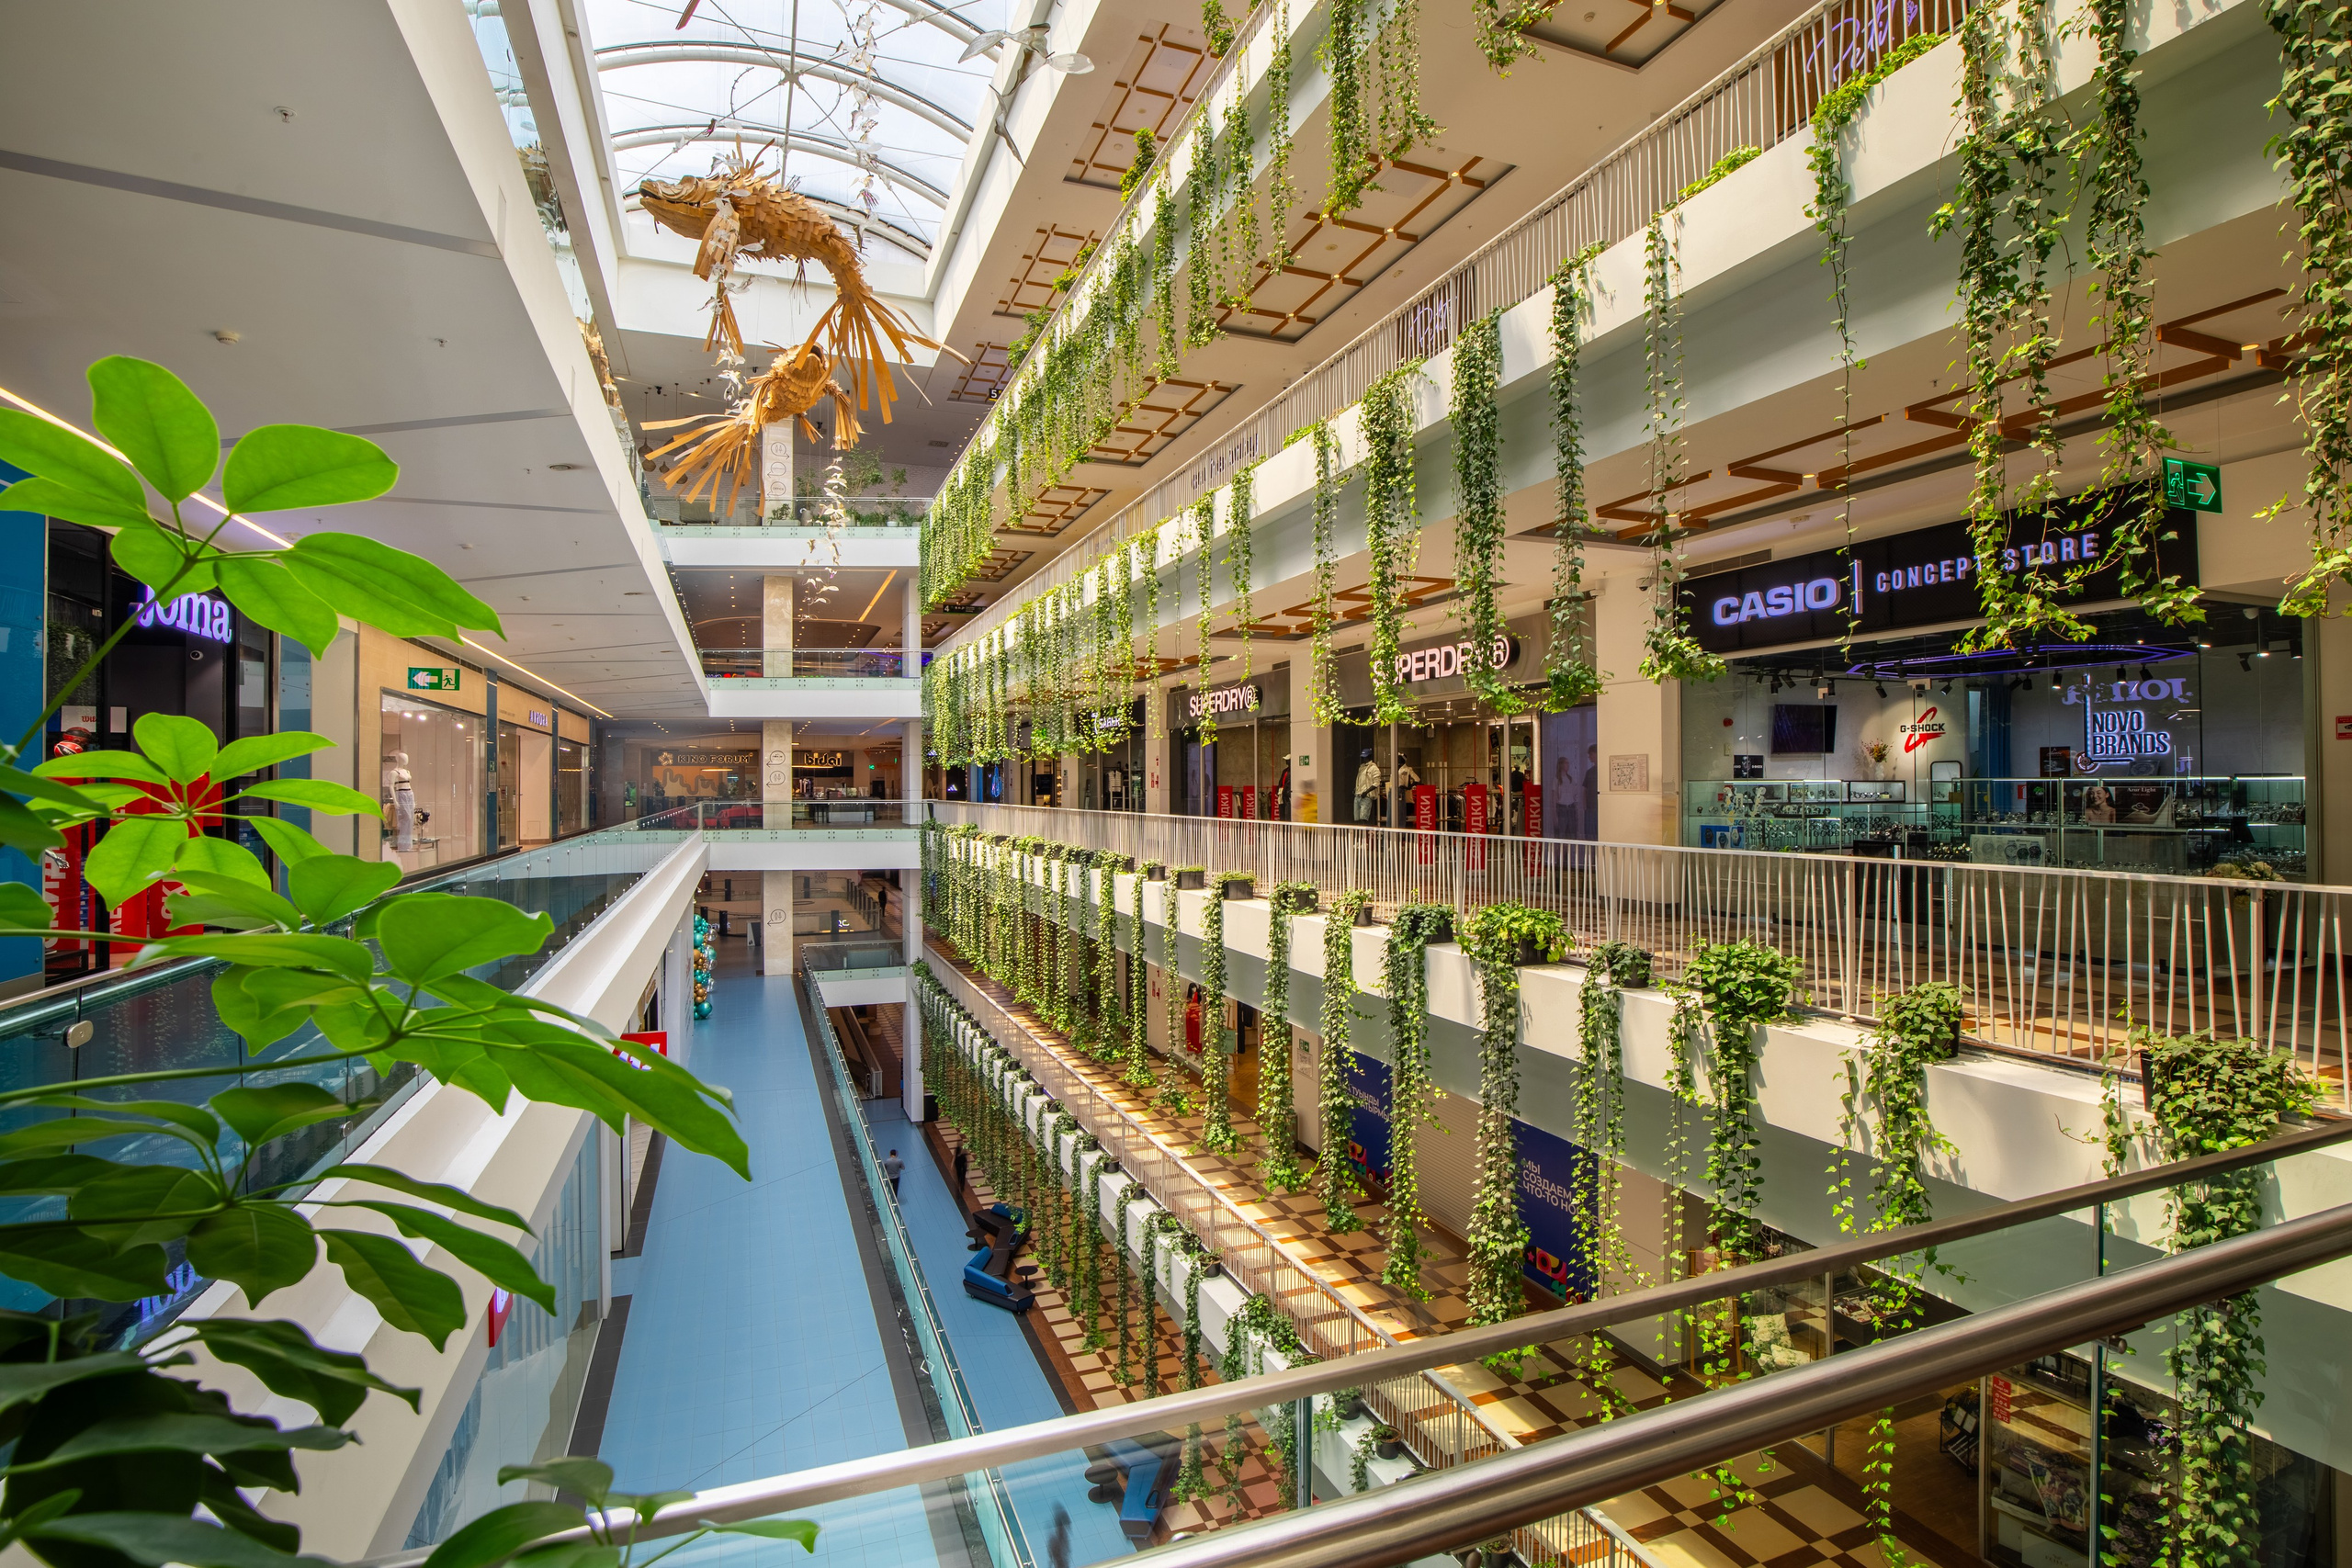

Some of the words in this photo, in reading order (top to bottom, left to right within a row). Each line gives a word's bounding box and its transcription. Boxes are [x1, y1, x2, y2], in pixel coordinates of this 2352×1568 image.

[990, 389, 998, 399] 5
[2003, 533, 2100, 572] STORE
[944, 604, 950, 613] 4
[1713, 578, 1841, 626] CASIO
[1900, 722, 1946, 733] G-SHOCK
[2091, 710, 2144, 734] NOVO
[2091, 731, 2171, 755] BRANDS
[677, 754, 707, 764] KINO
[709, 753, 750, 764] FORUM
[1522, 1169, 1573, 1201] СОЗДАЕМ
[1522, 1180, 1559, 1207] ЧТО-ТО
